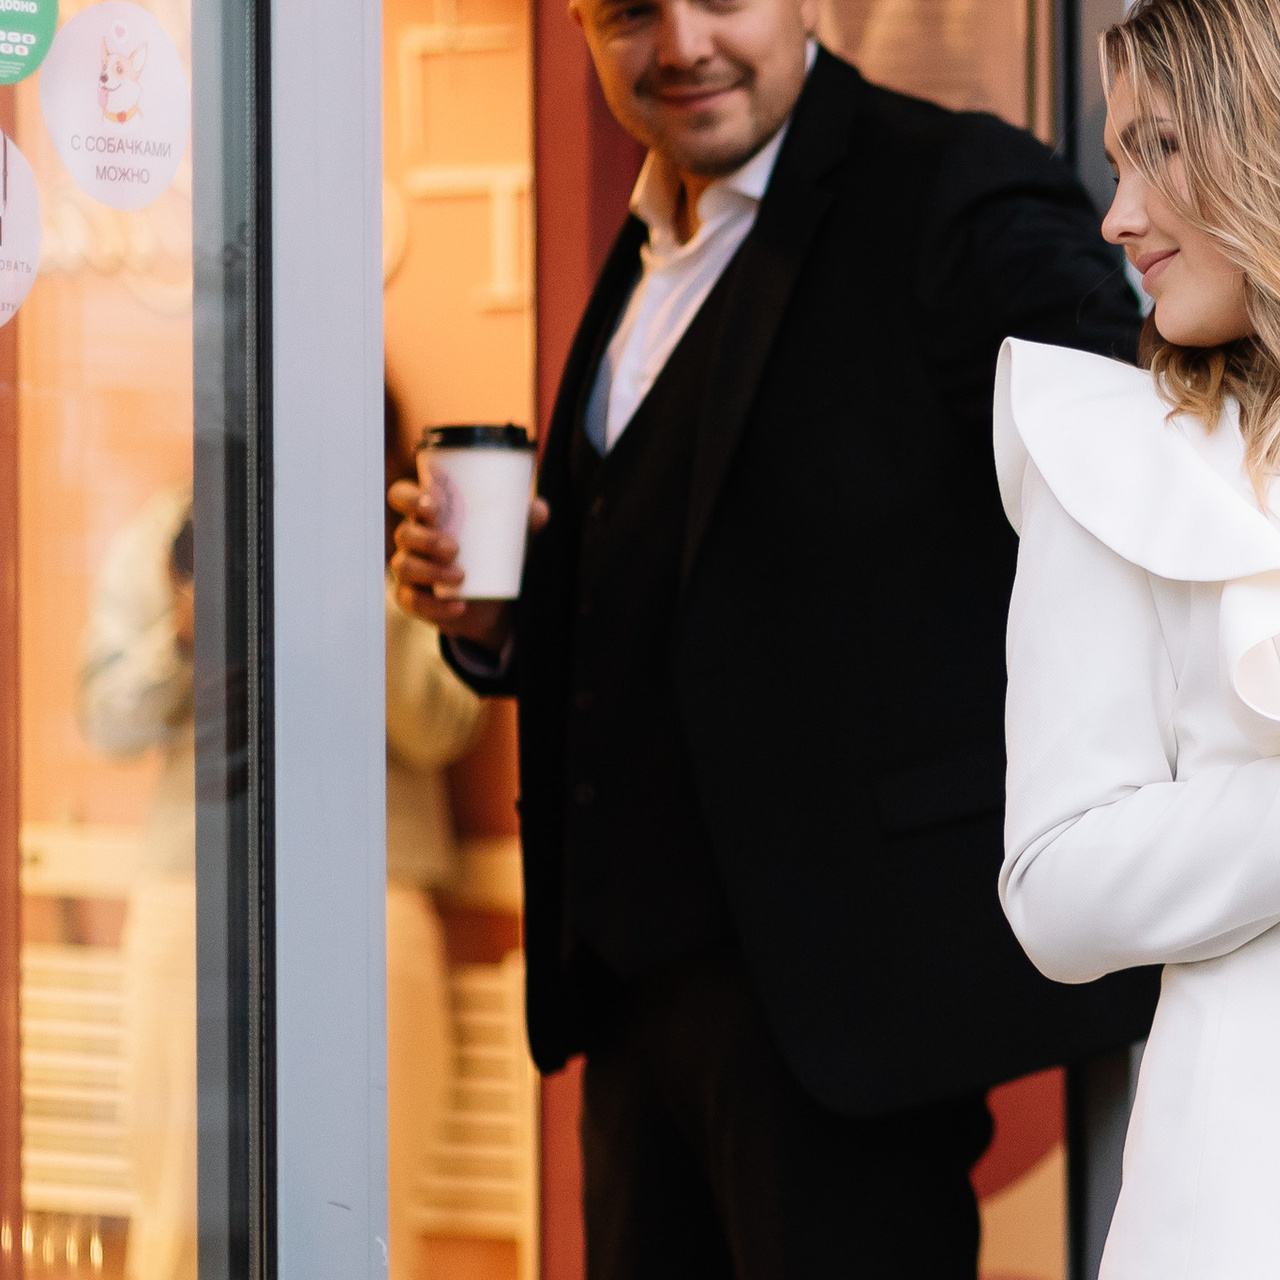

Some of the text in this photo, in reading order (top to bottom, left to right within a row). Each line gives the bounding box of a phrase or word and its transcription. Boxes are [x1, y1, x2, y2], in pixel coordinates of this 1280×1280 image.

[71, 135, 171, 158] С СОБАЧКАМИ
[95, 165, 150, 184] МОЖНО
